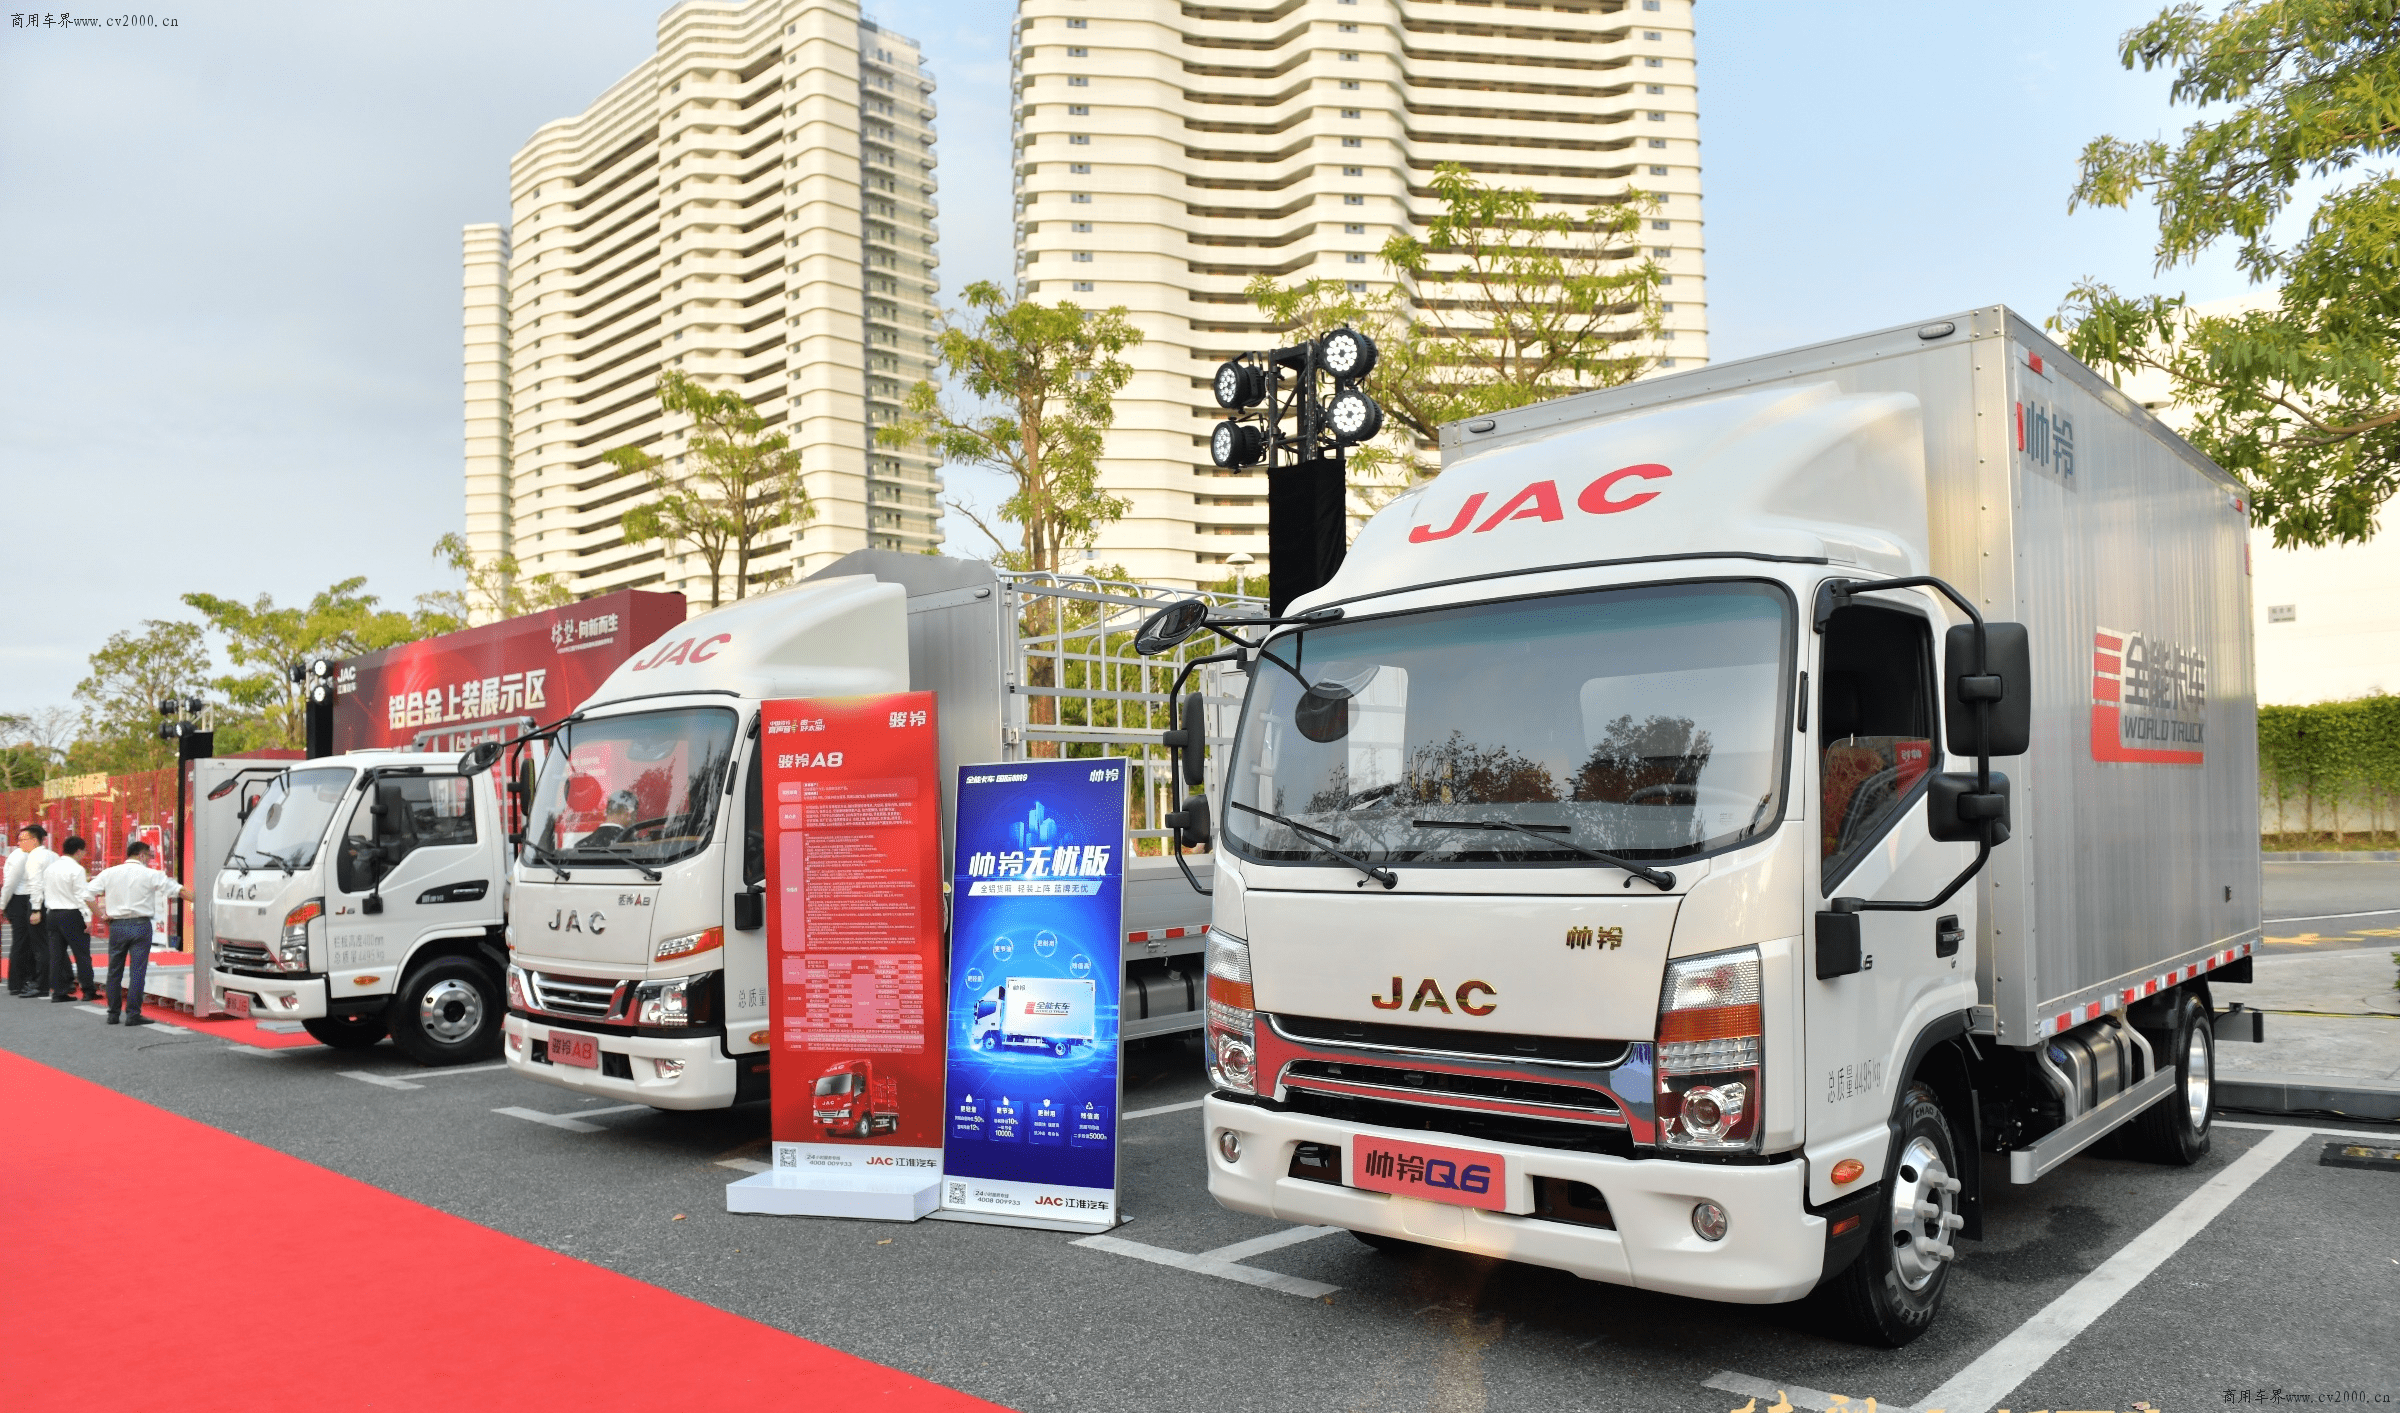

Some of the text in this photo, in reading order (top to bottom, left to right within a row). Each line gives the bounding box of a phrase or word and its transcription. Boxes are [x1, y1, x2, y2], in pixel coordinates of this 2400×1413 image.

[2025, 401, 2074, 479] 帅铃
[1408, 463, 1673, 544] JAC
[632, 633, 732, 671] JAC
[337, 666, 356, 683] JAC
[2124, 634, 2206, 711] 全能卡车
[388, 669, 546, 731] 铝合金上装展示区
[889, 710, 927, 728] 骏铃
[2124, 715, 2205, 743] WORLD TRUCK
[778, 752, 844, 769] 骏铃A8
[1089, 768, 1119, 783] 帅铃
[968, 845, 1111, 877] 帅铃无忧版
[226, 884, 258, 900] JAC
[1018, 884, 1051, 894] 轻装上阵
[1054, 884, 1089, 894] 蓝牌无忧
[548, 908, 607, 935] JAC
[1566, 926, 1623, 950] 帅铃
[1036, 1002, 1070, 1010] 全能卡车
[1371, 976, 1498, 1017] JAC
[551, 1038, 592, 1060] 骏铃A8
[866, 1156, 937, 1168] JAC 江淮汽车
[1365, 1149, 1491, 1194] 帅铃Q6
[1035, 1196, 1109, 1211] JAC 江淮汽车
